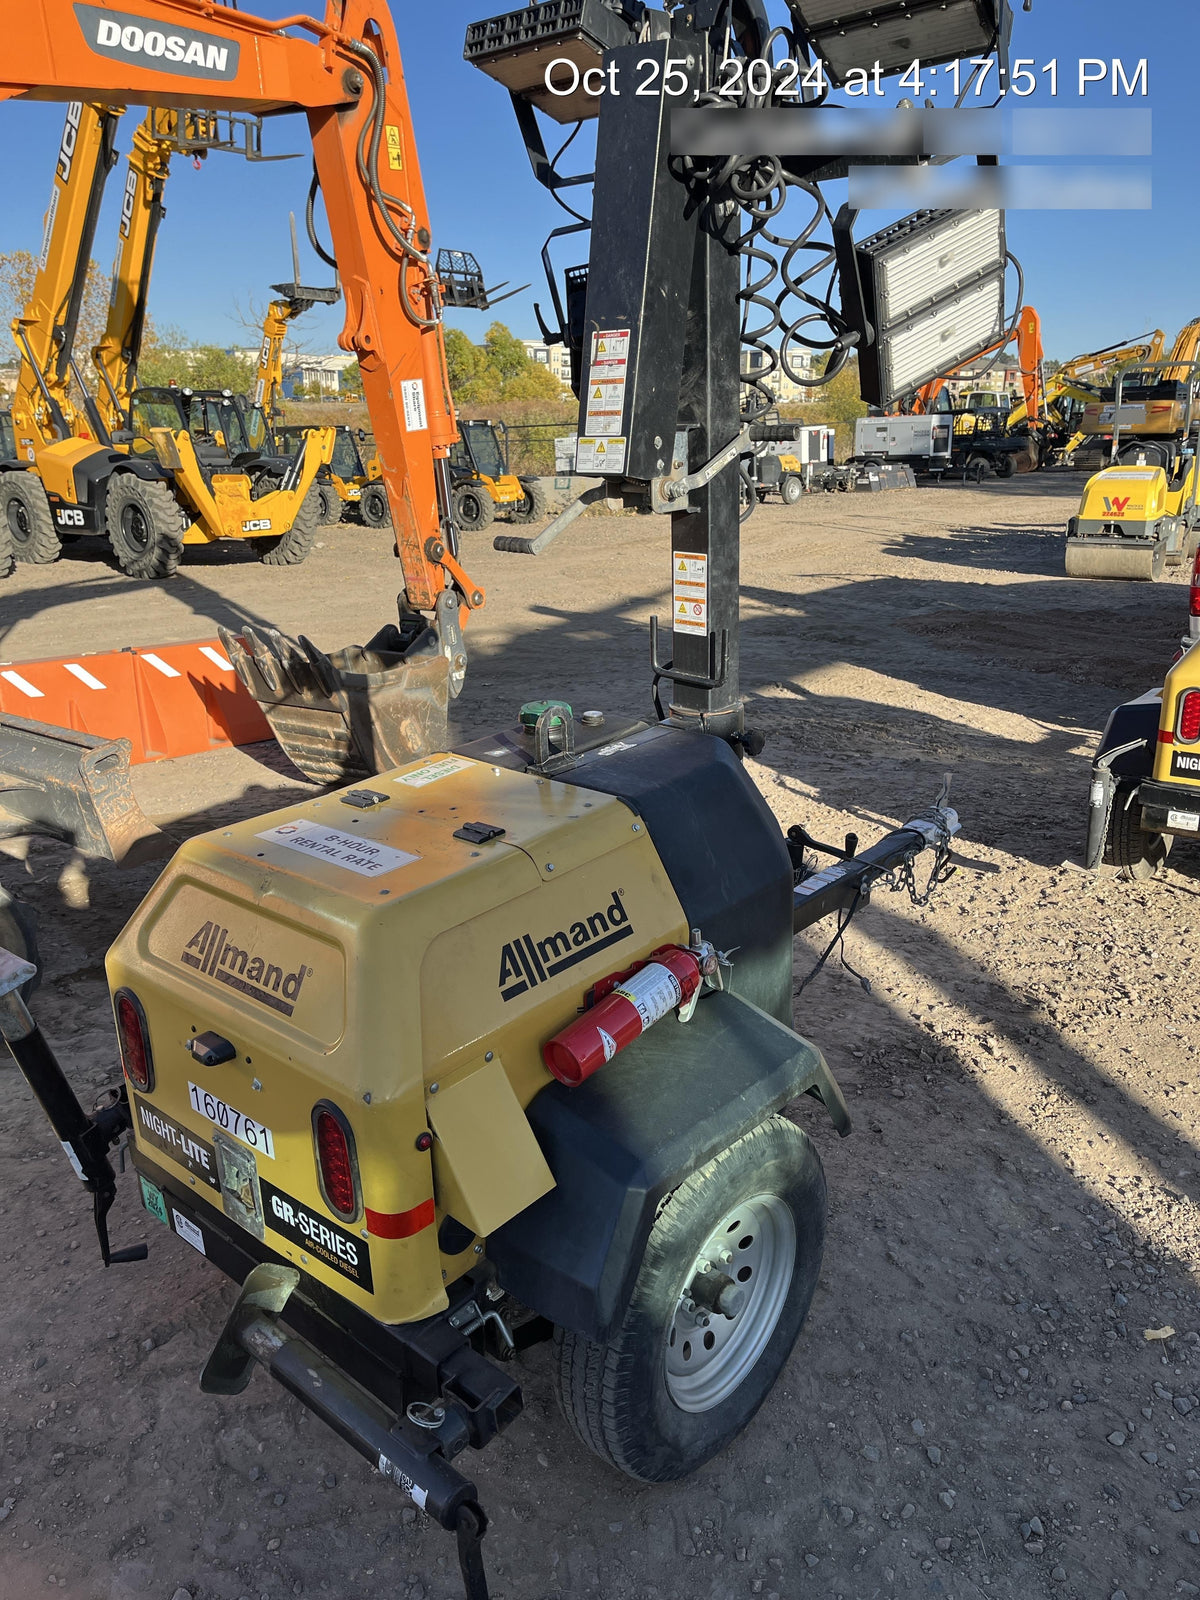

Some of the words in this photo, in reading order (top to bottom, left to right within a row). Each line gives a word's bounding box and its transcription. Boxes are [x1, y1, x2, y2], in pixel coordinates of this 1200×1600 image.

[97, 19, 228, 71] DOOSAN
[56, 101, 83, 185] JCB
[120, 168, 139, 239] JCB
[260, 336, 271, 369] JCB
[57, 509, 85, 526] JCB
[242, 519, 272, 531] JCB
[402, 767, 433, 783] ONLY
[422, 764, 460, 782] DIESEL
[1176, 755, 1200, 771] NIG
[289, 836, 338, 858] RENTAL
[341, 853, 383, 871] RATE
[324, 834, 380, 856] 8-HOUR
[140, 1105, 211, 1170] NIGHT-LITE
[271, 1195, 358, 1266] GR-SERIES
[305, 1238, 339, 1265] AIR-COOLED
[339, 1260, 359, 1278] DIESEL
